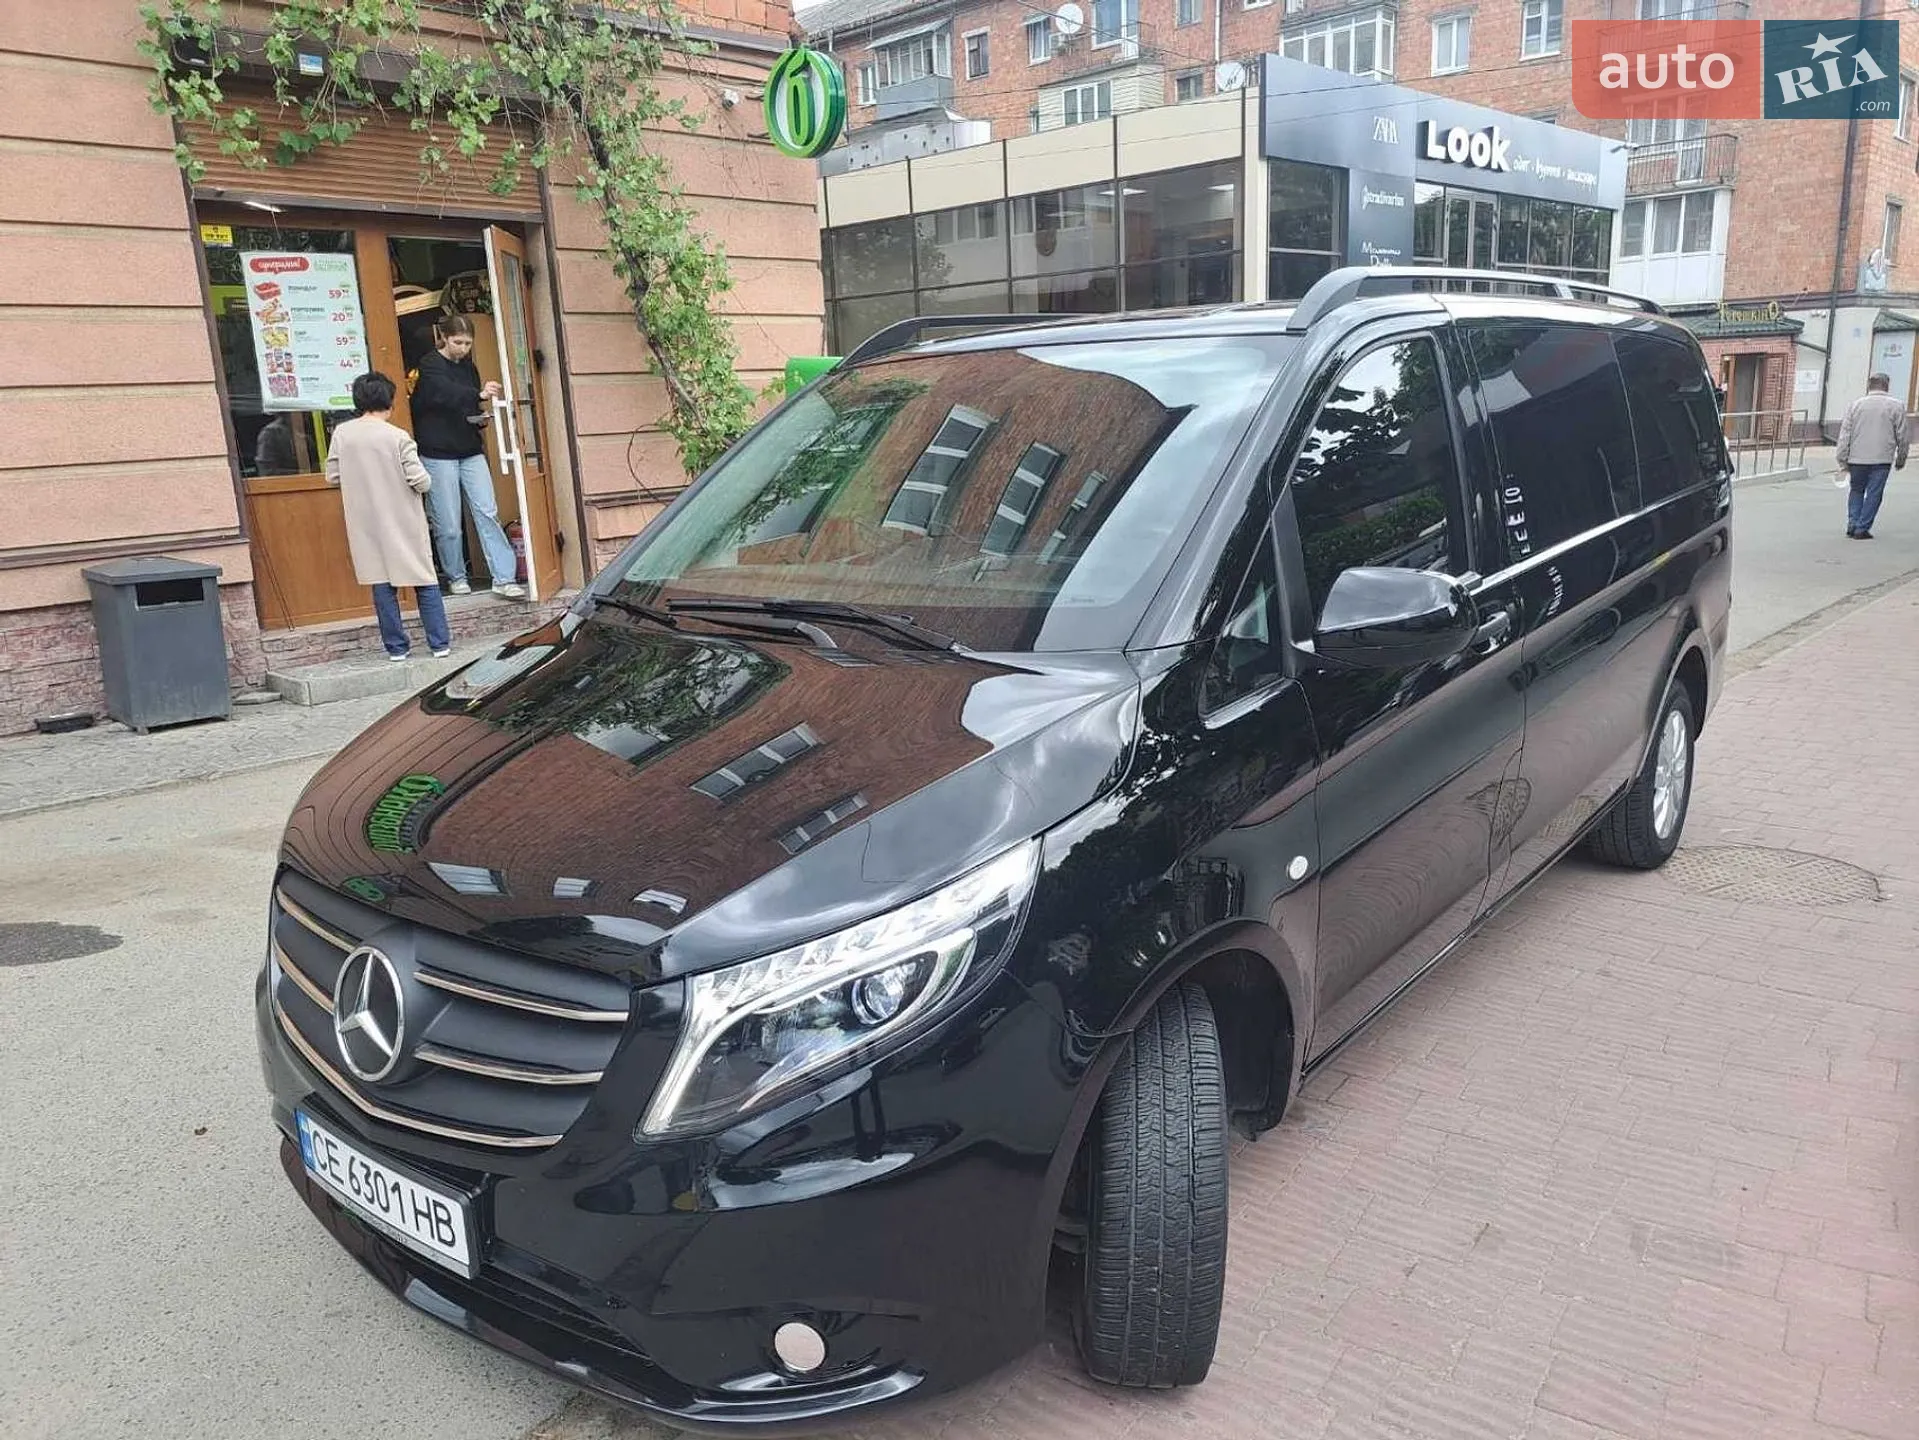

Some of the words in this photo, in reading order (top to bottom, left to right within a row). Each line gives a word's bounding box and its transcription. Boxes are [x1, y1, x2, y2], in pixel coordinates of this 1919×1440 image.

[312, 1130, 345, 1186] CE
[348, 1155, 406, 1225] 6301
[410, 1188, 456, 1248] HB
